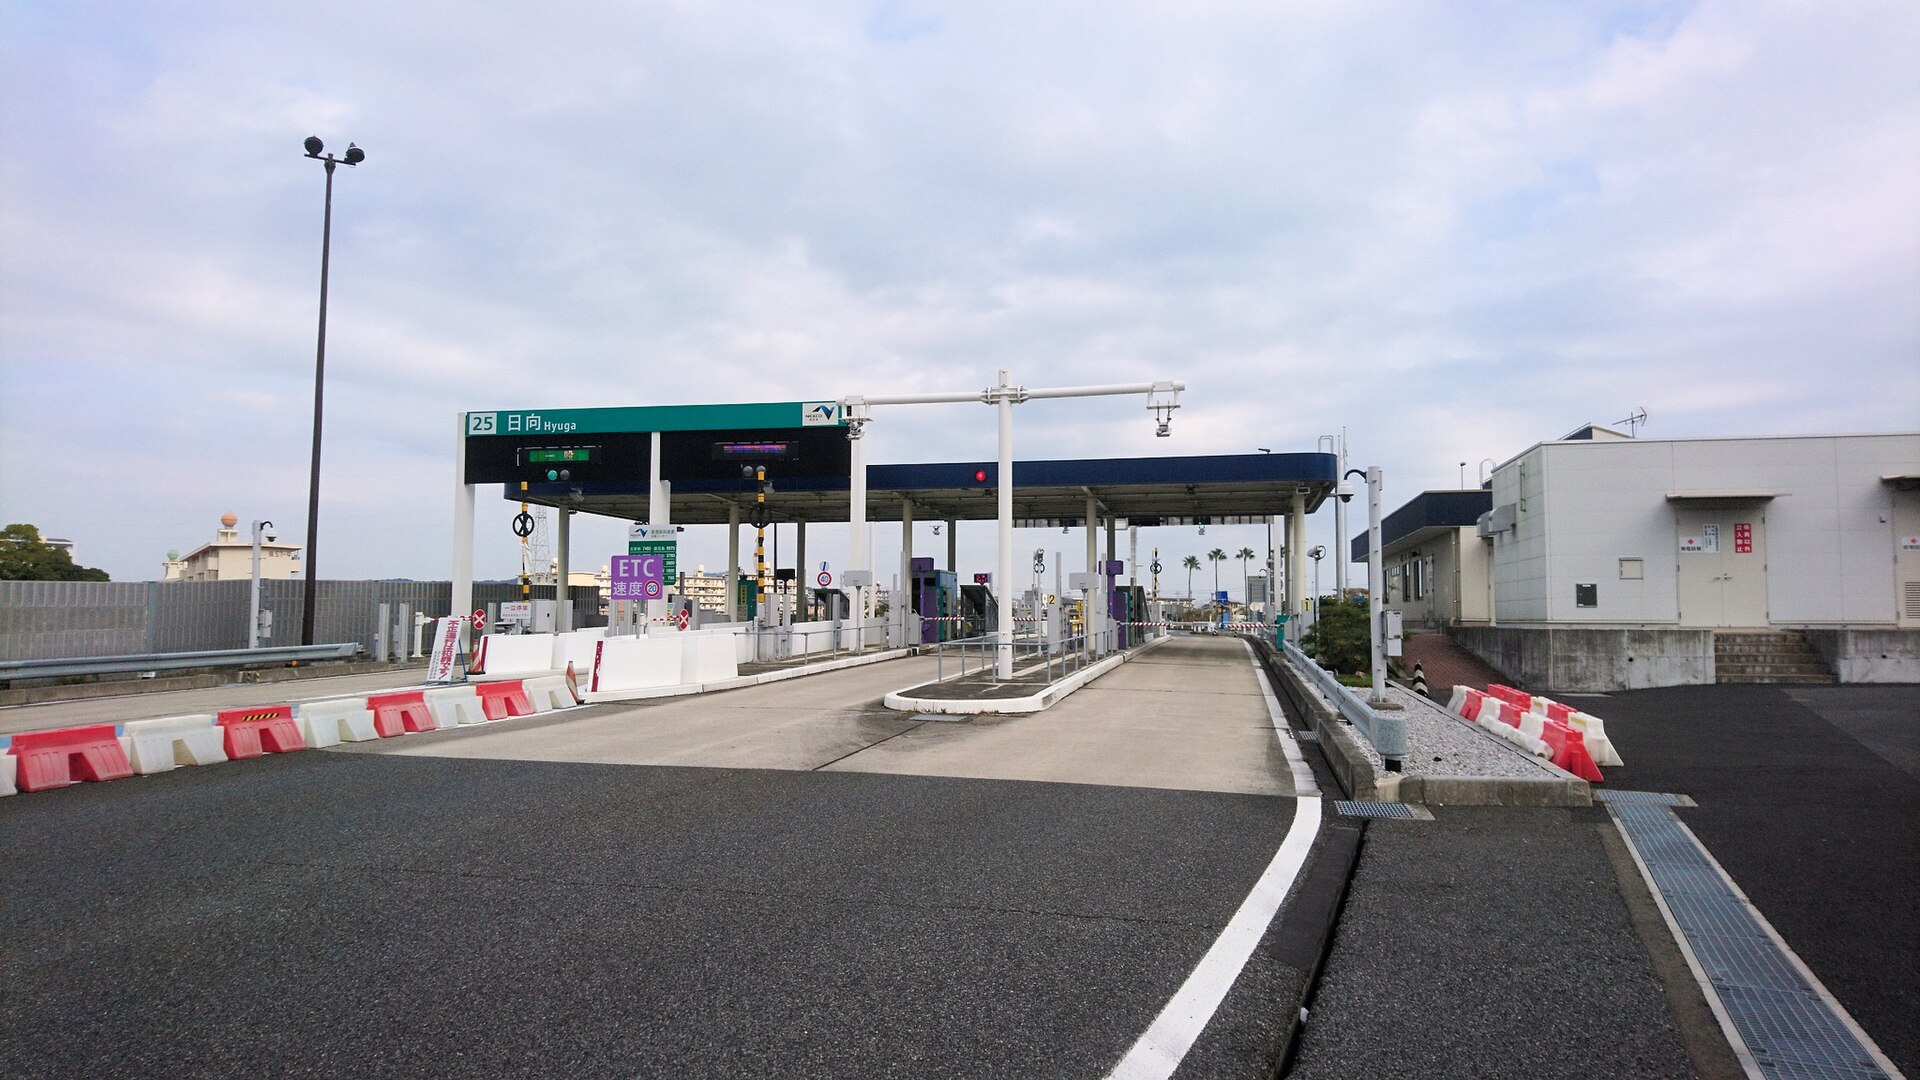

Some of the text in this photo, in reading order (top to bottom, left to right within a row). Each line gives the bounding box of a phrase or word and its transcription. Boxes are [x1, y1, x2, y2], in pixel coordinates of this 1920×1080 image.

[473, 413, 577, 432] 25 日向 Hyuga
[619, 559, 655, 577] ETC
[820, 575, 829, 583] 40
[612, 581, 657, 596] 速度 20
[1049, 594, 1055, 605] 2
